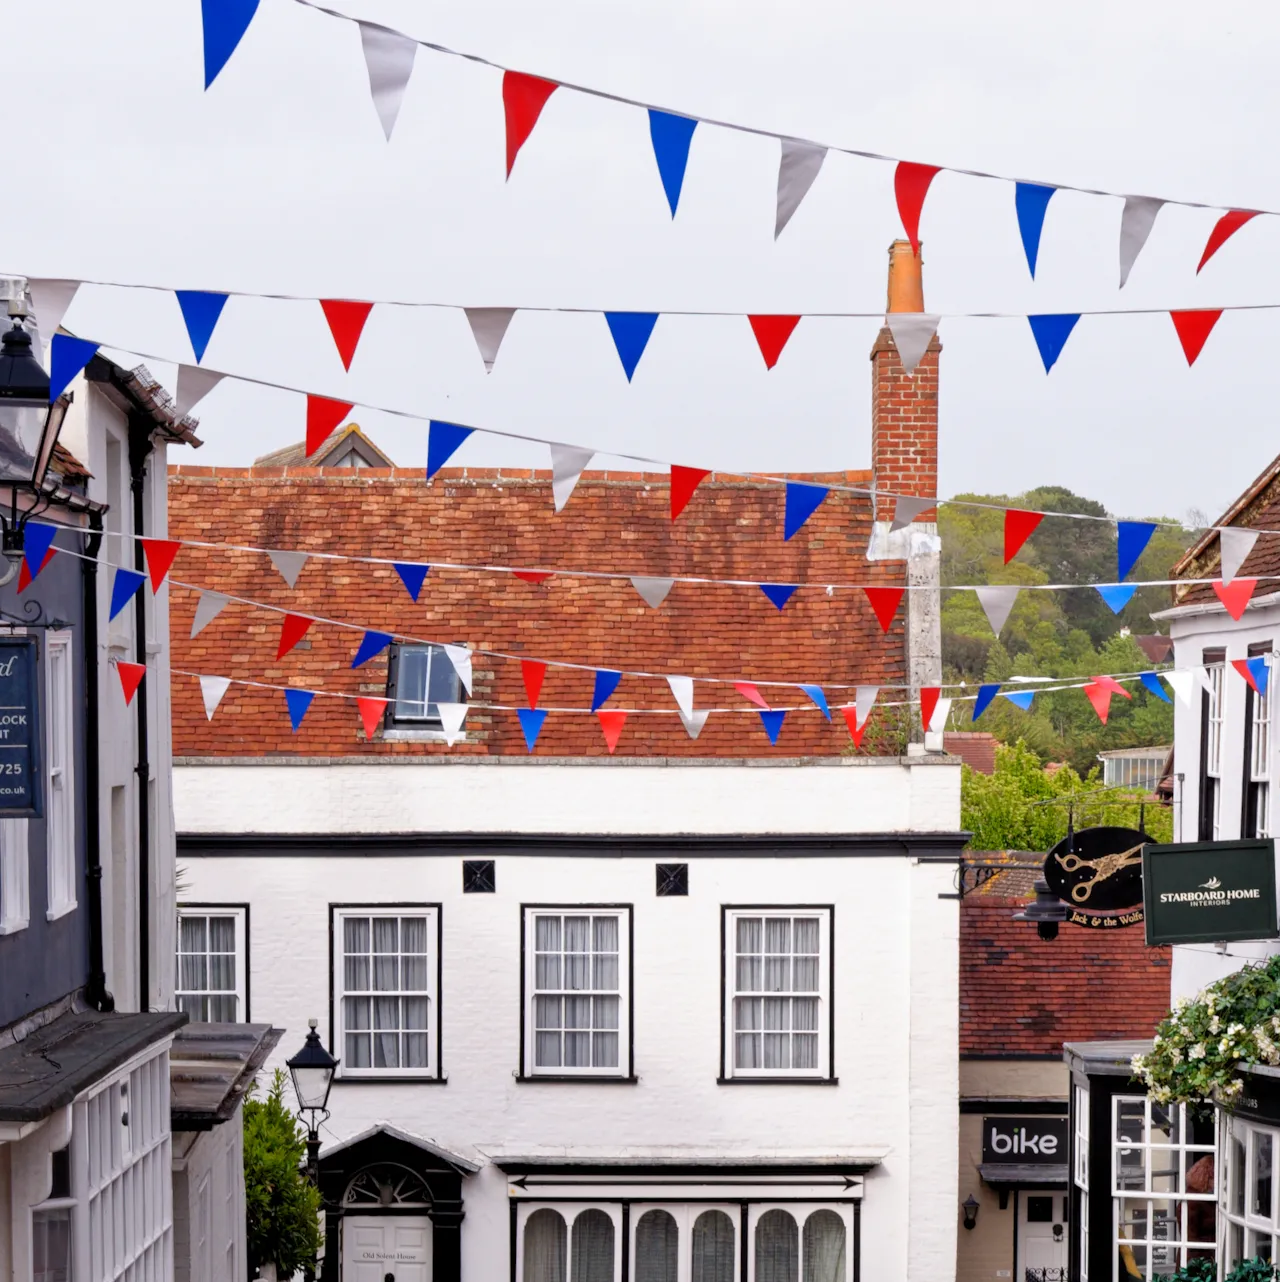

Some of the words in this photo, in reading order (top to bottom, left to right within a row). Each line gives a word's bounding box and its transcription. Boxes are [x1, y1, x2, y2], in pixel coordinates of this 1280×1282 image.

[1160, 889, 1226, 903] STARBOARD
[1227, 888, 1260, 900] HOME
[1190, 899, 1231, 907] INTERIORS
[1070, 911, 1087, 925] Jack
[1091, 916, 1102, 927] &
[1104, 916, 1118, 927] the
[1119, 909, 1144, 926] Wolfe
[991, 1127, 1058, 1155] bike
[362, 1251, 375, 1259] Old
[376, 1252, 395, 1260] Solent
